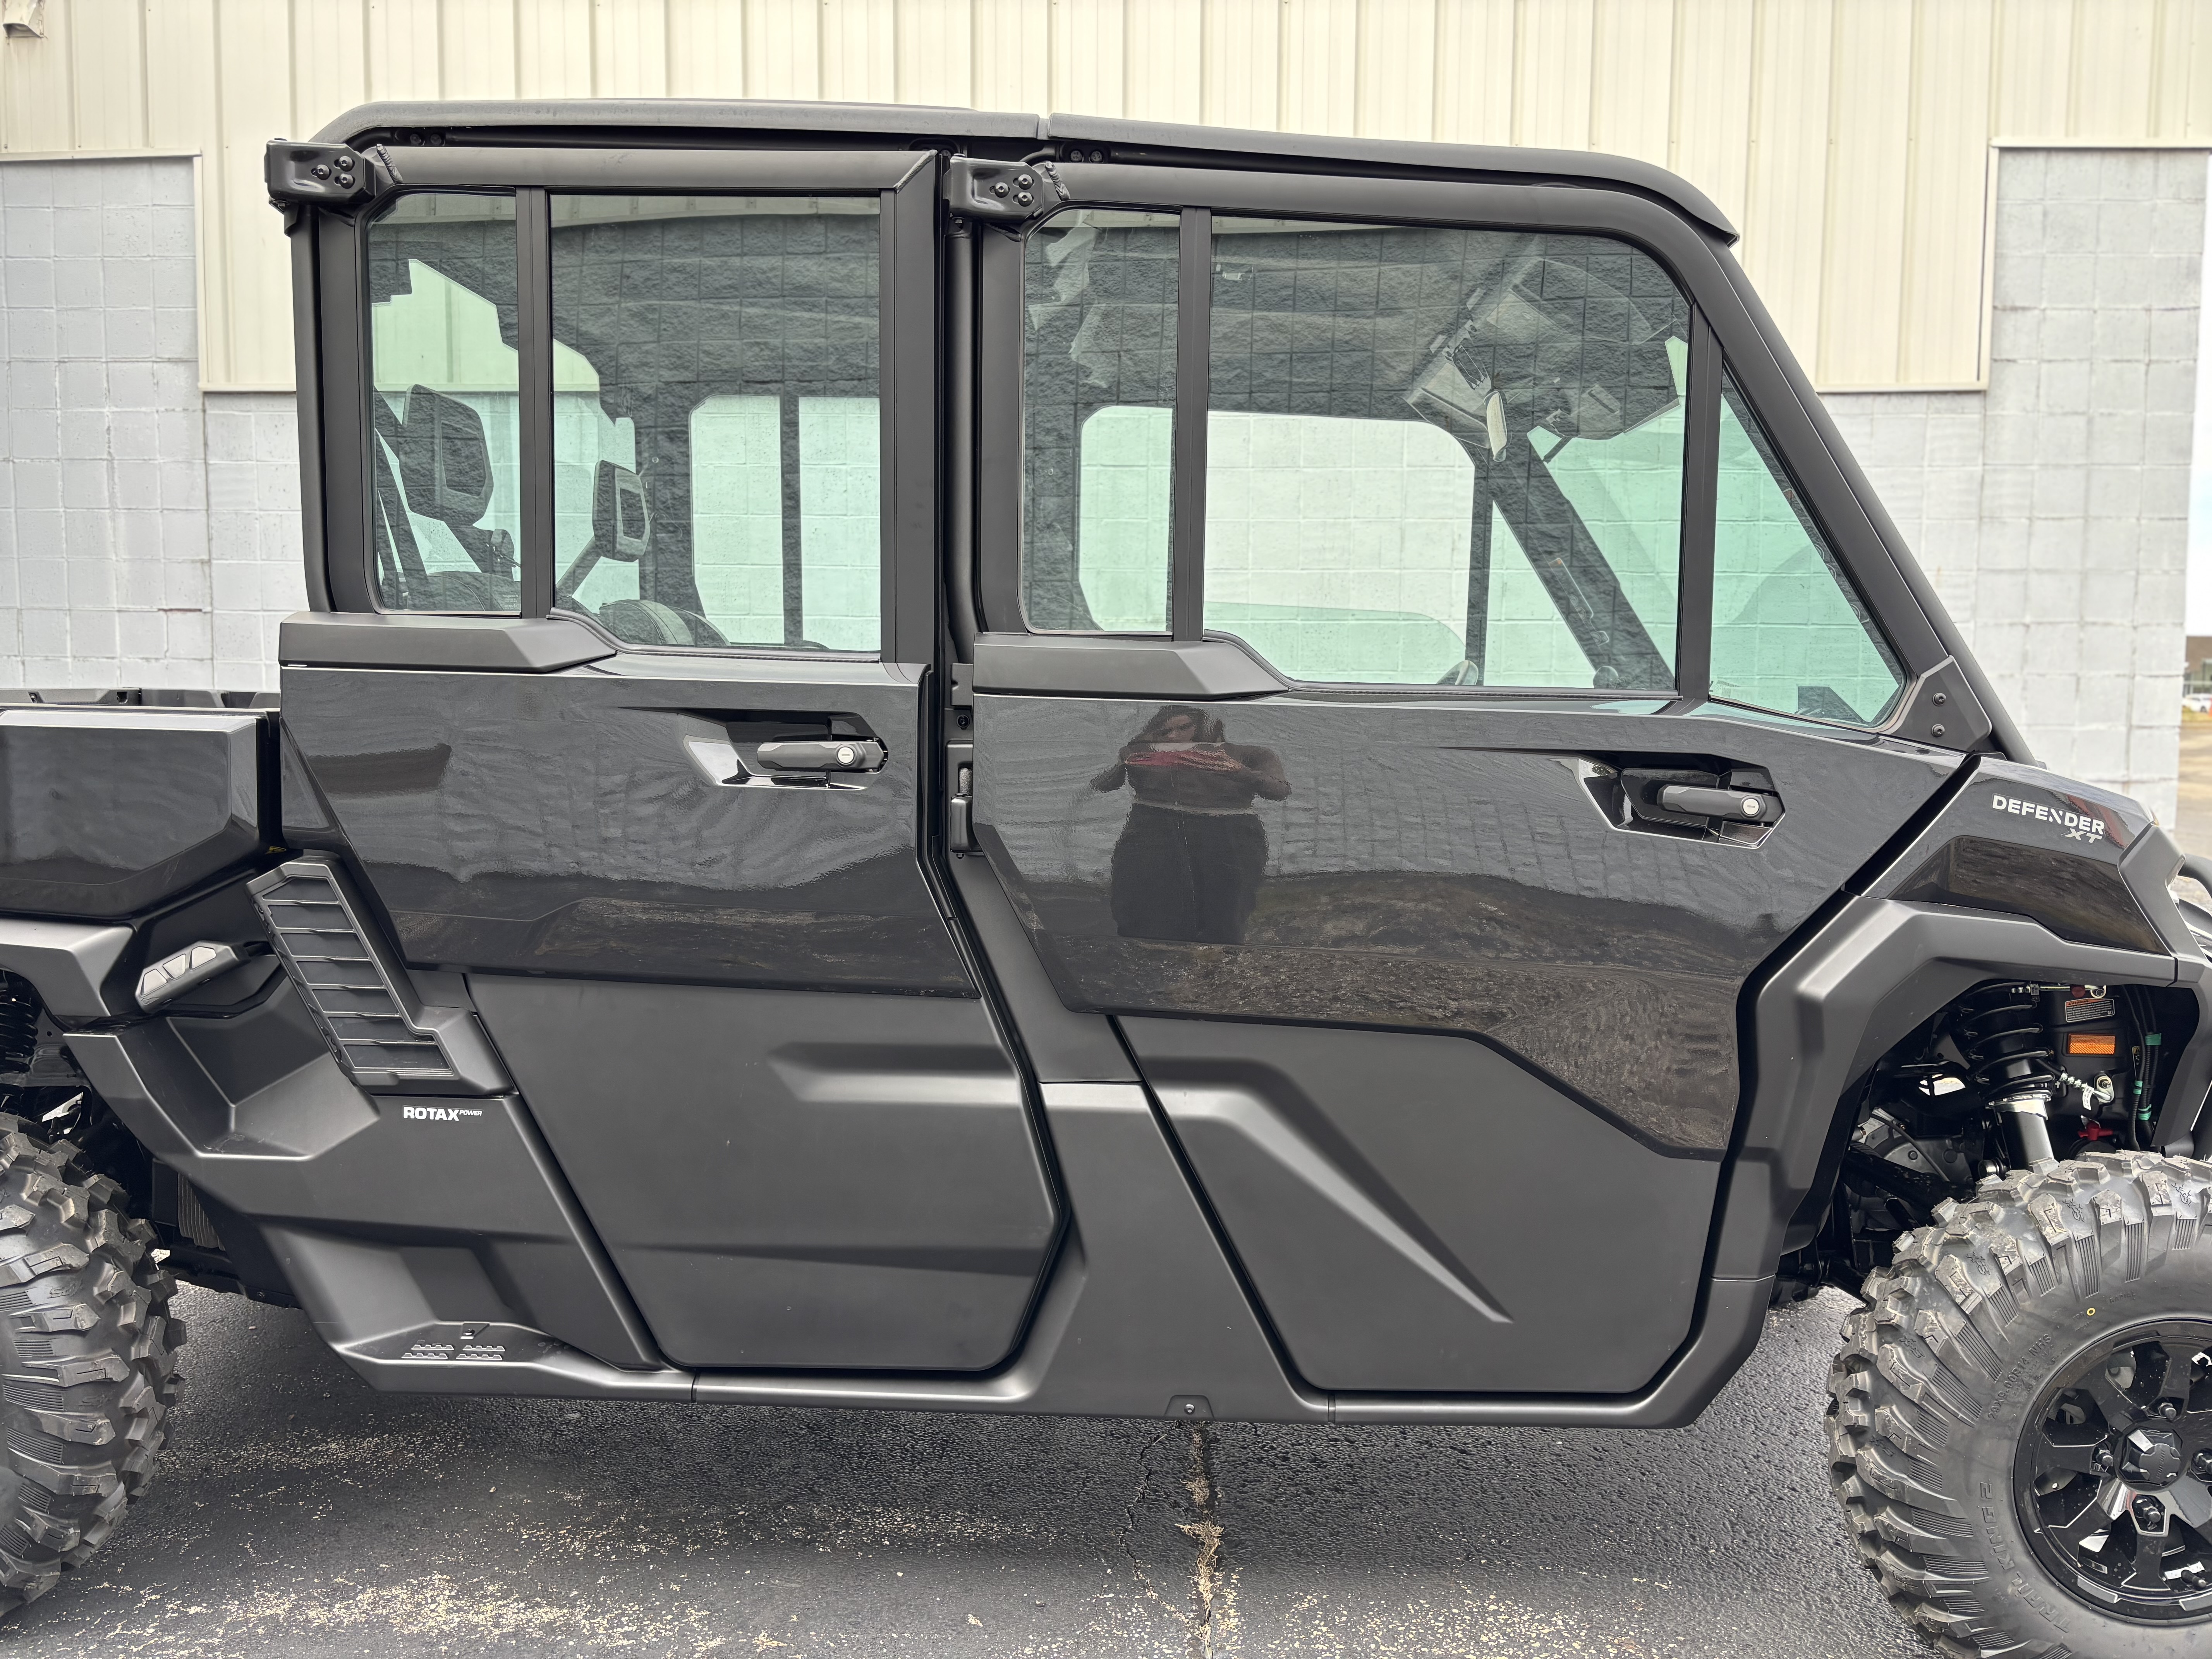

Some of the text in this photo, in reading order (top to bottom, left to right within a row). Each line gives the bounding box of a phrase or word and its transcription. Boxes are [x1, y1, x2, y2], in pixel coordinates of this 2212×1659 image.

[1992, 795, 2105, 835] DEFENDER
[2064, 828, 2102, 843] XT
[404, 1106, 459, 1121] ROTAX
[2029, 1334, 2051, 1356] NHS
[1982, 1506, 2015, 1570] KING
[2011, 1570, 2071, 1633] TRAIL
